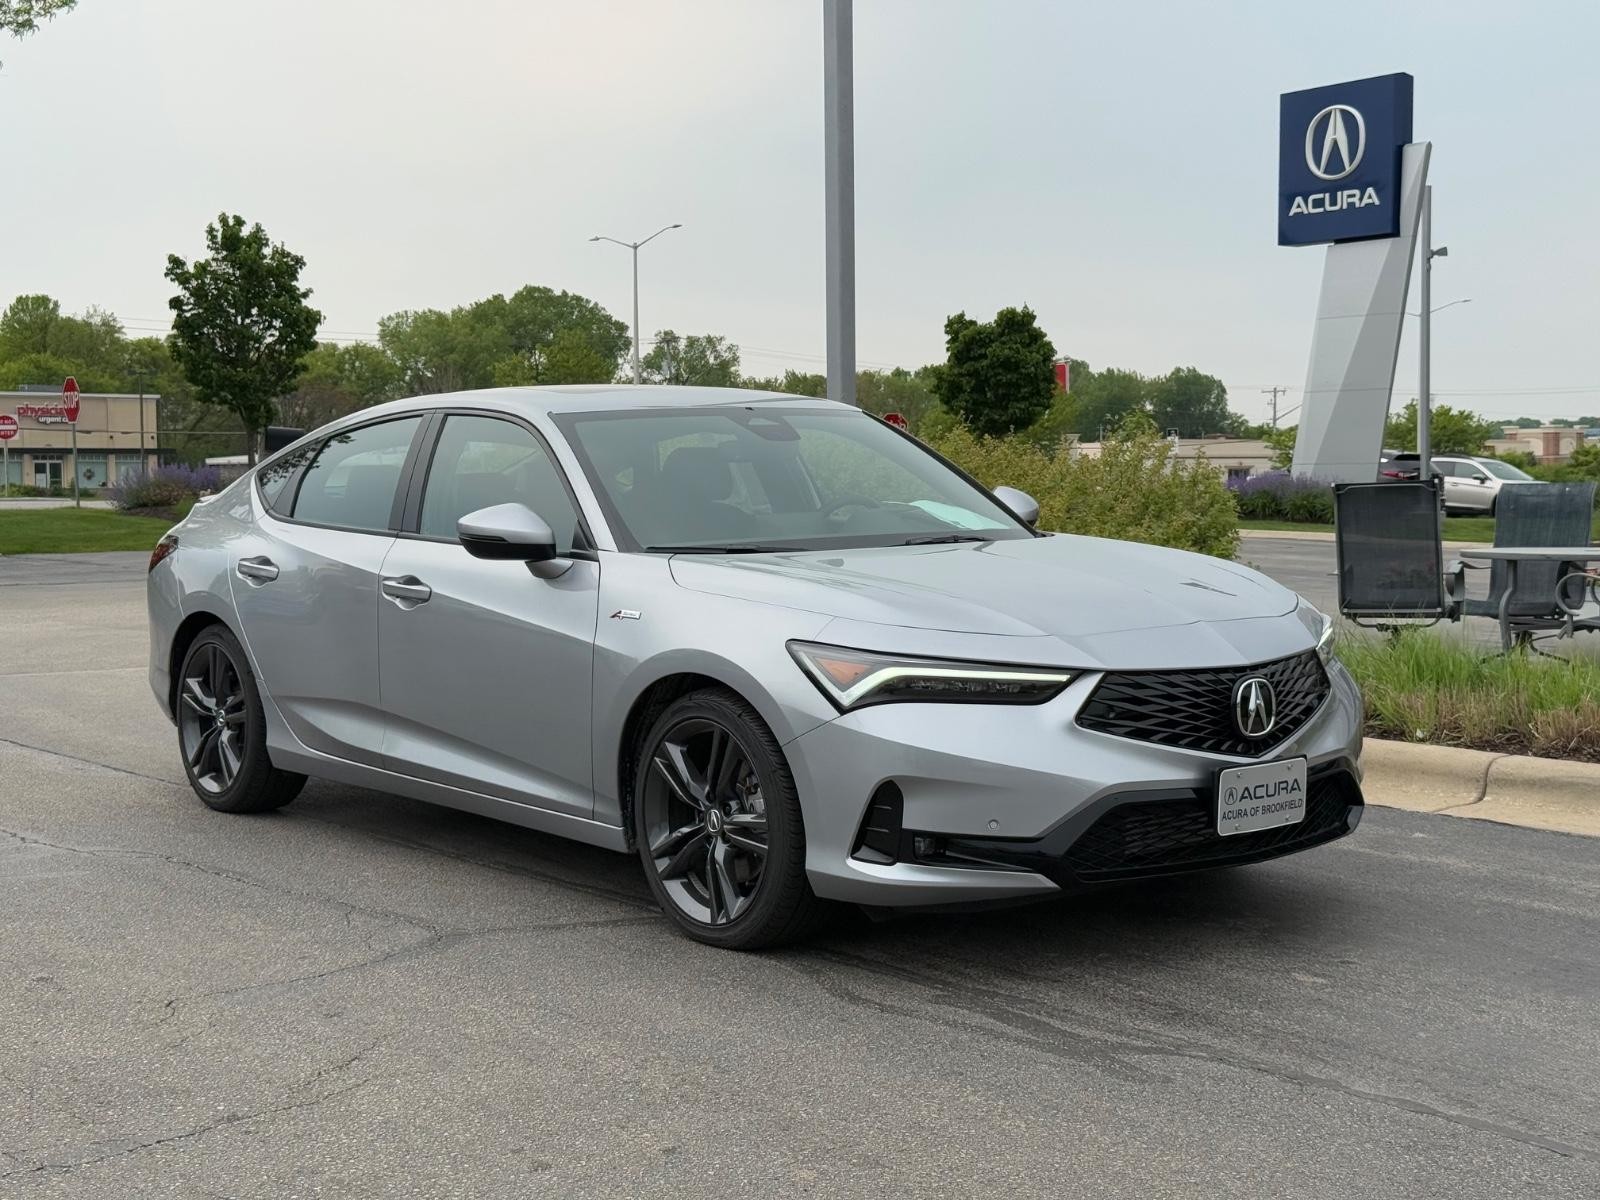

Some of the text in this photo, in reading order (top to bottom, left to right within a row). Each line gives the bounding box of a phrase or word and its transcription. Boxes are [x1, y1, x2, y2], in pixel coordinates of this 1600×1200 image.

[1288, 187, 1380, 216] ACURA
[65, 391, 78, 408] STOP
[39, 416, 61, 424] urgent
[1239, 778, 1301, 802] ACURA
[1222, 798, 1303, 821] ACURA OF BROOKFIELD
